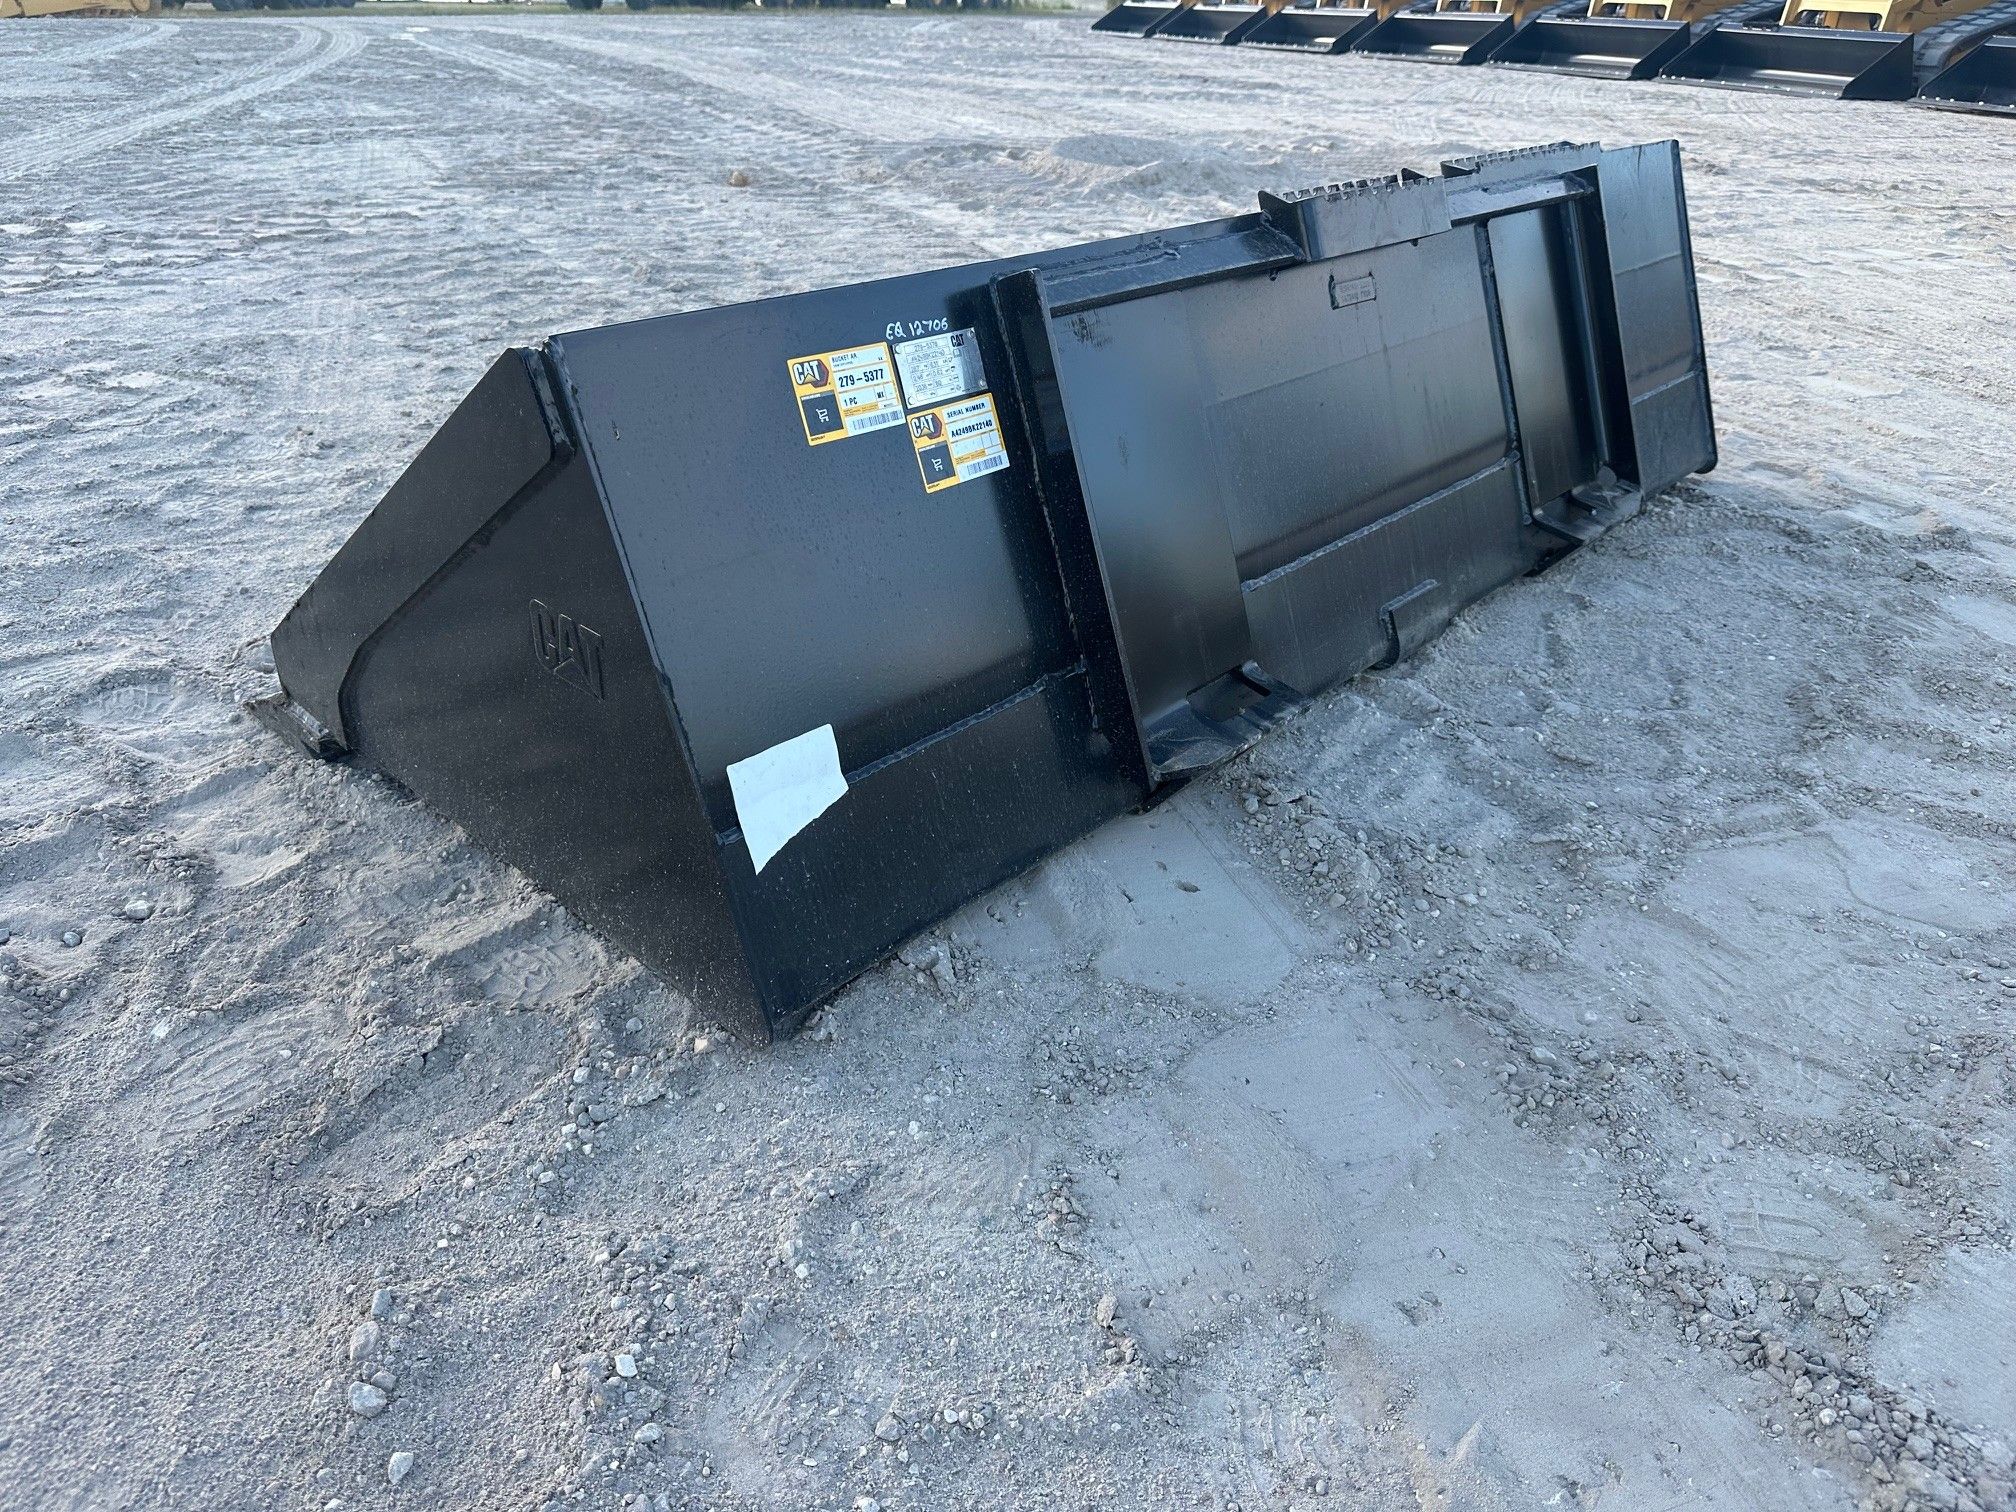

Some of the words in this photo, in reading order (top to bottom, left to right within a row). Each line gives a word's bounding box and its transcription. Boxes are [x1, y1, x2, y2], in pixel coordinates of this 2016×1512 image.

[886, 321, 906, 340] EQ
[908, 317, 948, 337] 12706
[950, 333, 965, 347] CAT
[793, 360, 820, 385] CAT
[838, 368, 884, 388] 279-5377
[849, 396, 858, 405] PC
[947, 408, 964, 418] SERIAL
[965, 402, 986, 412] NUMBER
[911, 413, 935, 438] CAT
[528, 598, 605, 704] CAT
